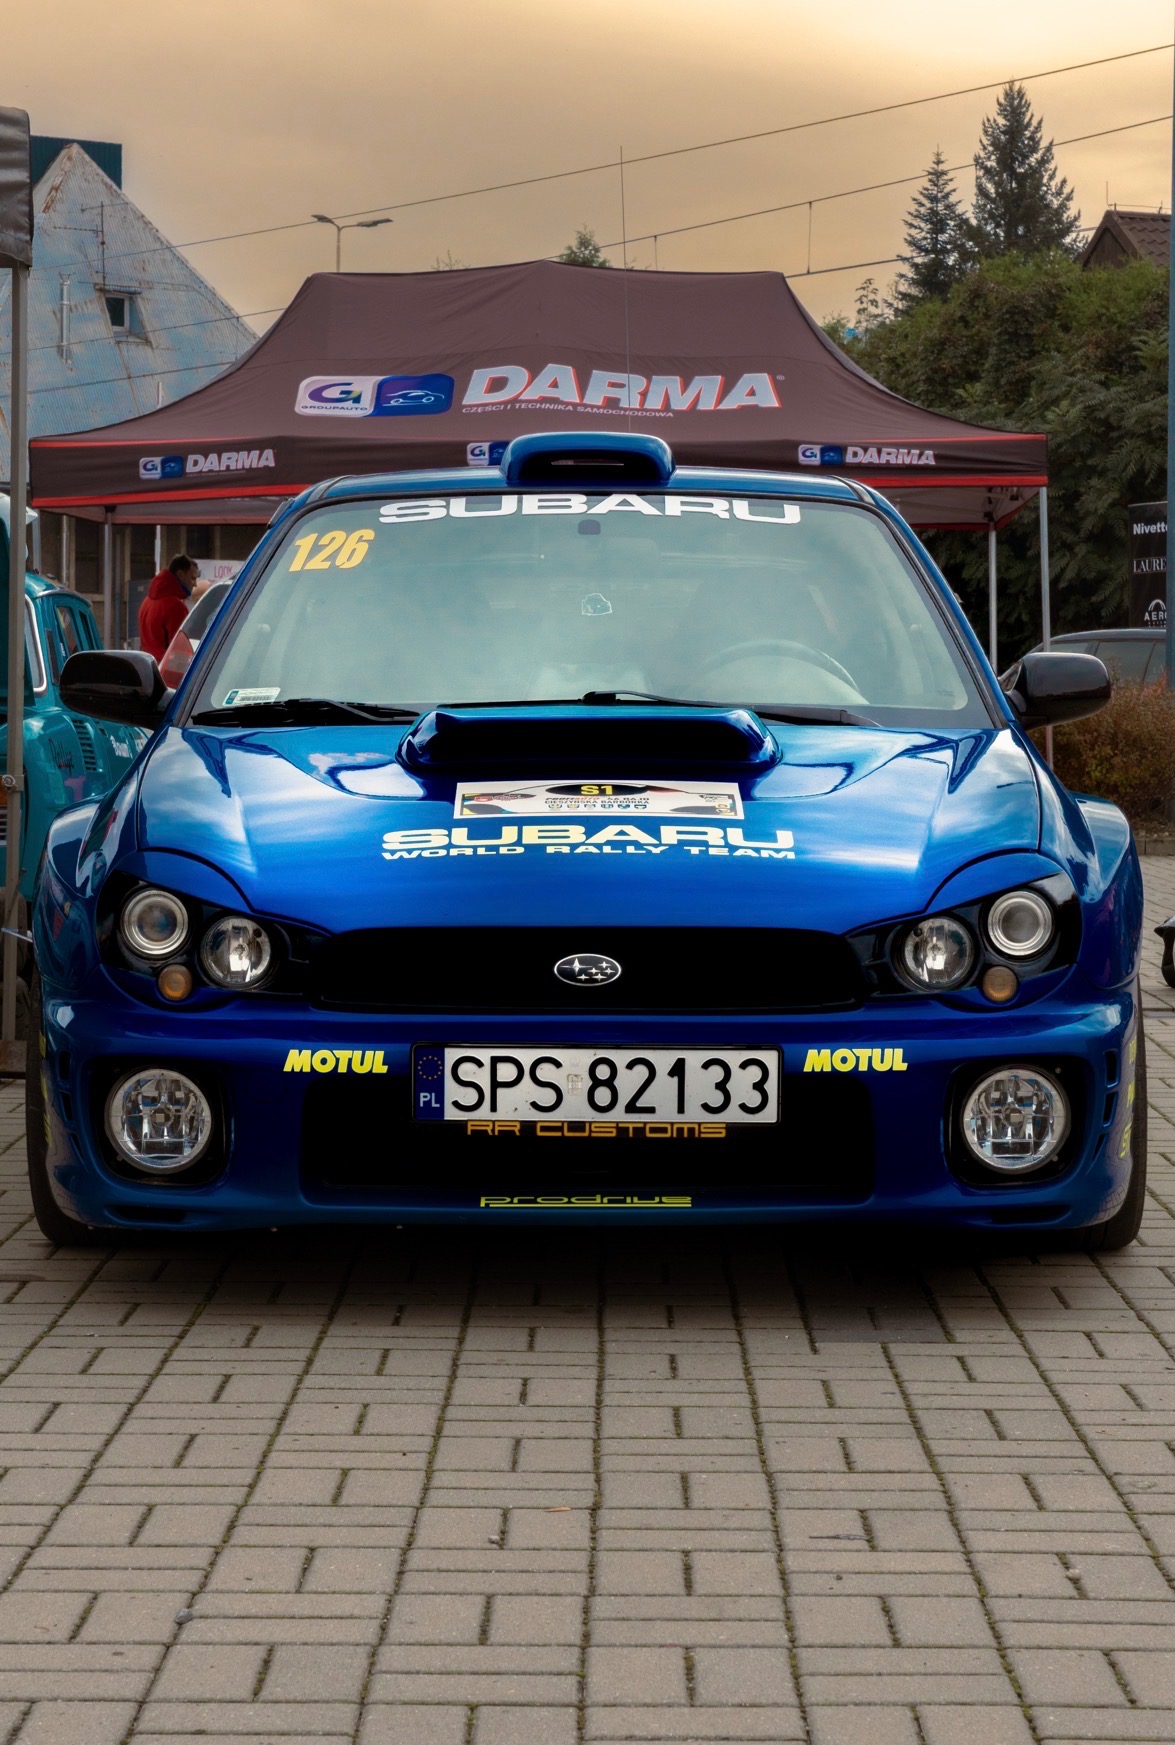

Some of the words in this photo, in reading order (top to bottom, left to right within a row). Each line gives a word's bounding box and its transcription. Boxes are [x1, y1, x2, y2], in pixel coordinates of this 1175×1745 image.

[462, 363, 782, 411] DARMA
[462, 404, 504, 413] CZĘŚCI
[514, 403, 574, 411] TECHNIKA
[576, 406, 674, 418] SAMOCHODOWA
[185, 449, 275, 473] DARMA
[845, 446, 936, 465] DARMA
[378, 494, 801, 525] SUBARU
[289, 528, 375, 572] 126
[581, 785, 613, 795] S1
[382, 824, 795, 849] SUBARU
[382, 845, 524, 860] WORLD
[546, 844, 669, 855] RALLY
[684, 845, 796, 859] TEAM
[283, 1049, 388, 1073] MOTUL
[803, 1048, 908, 1072] MOTUL
[450, 1055, 564, 1113] SPS
[587, 1057, 770, 1115] 82133
[419, 1092, 441, 1108] PL
[467, 1119, 521, 1135] RR
[536, 1121, 727, 1138] CUSTOMS
[480, 1194, 692, 1207] prodrive
